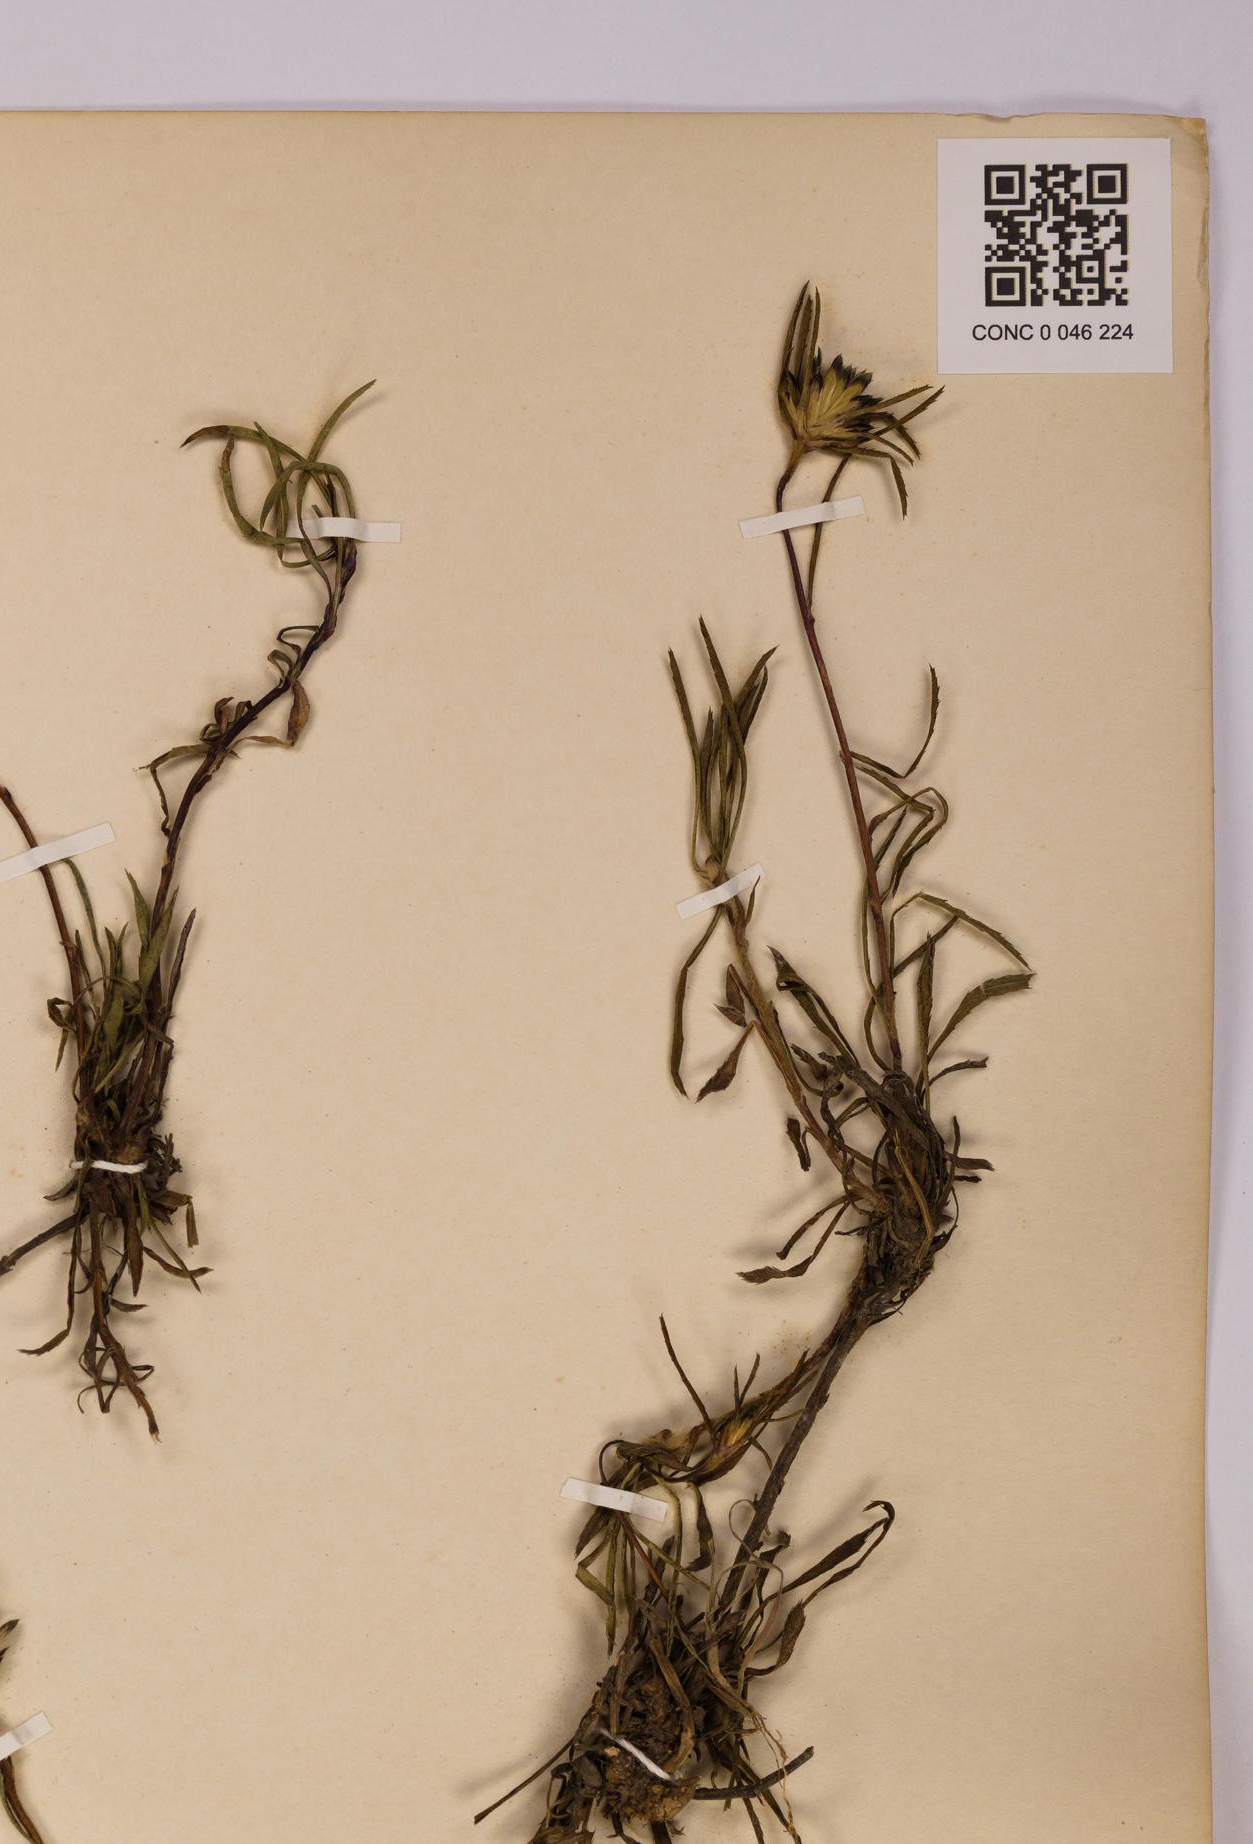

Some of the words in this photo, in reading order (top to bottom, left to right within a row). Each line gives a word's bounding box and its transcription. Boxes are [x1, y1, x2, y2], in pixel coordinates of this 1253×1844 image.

[971, 323, 1034, 342] CONC
[1039, 324, 1052, 341] 0
[1057, 323, 1093, 341] 046
[1098, 323, 1134, 341] 224
